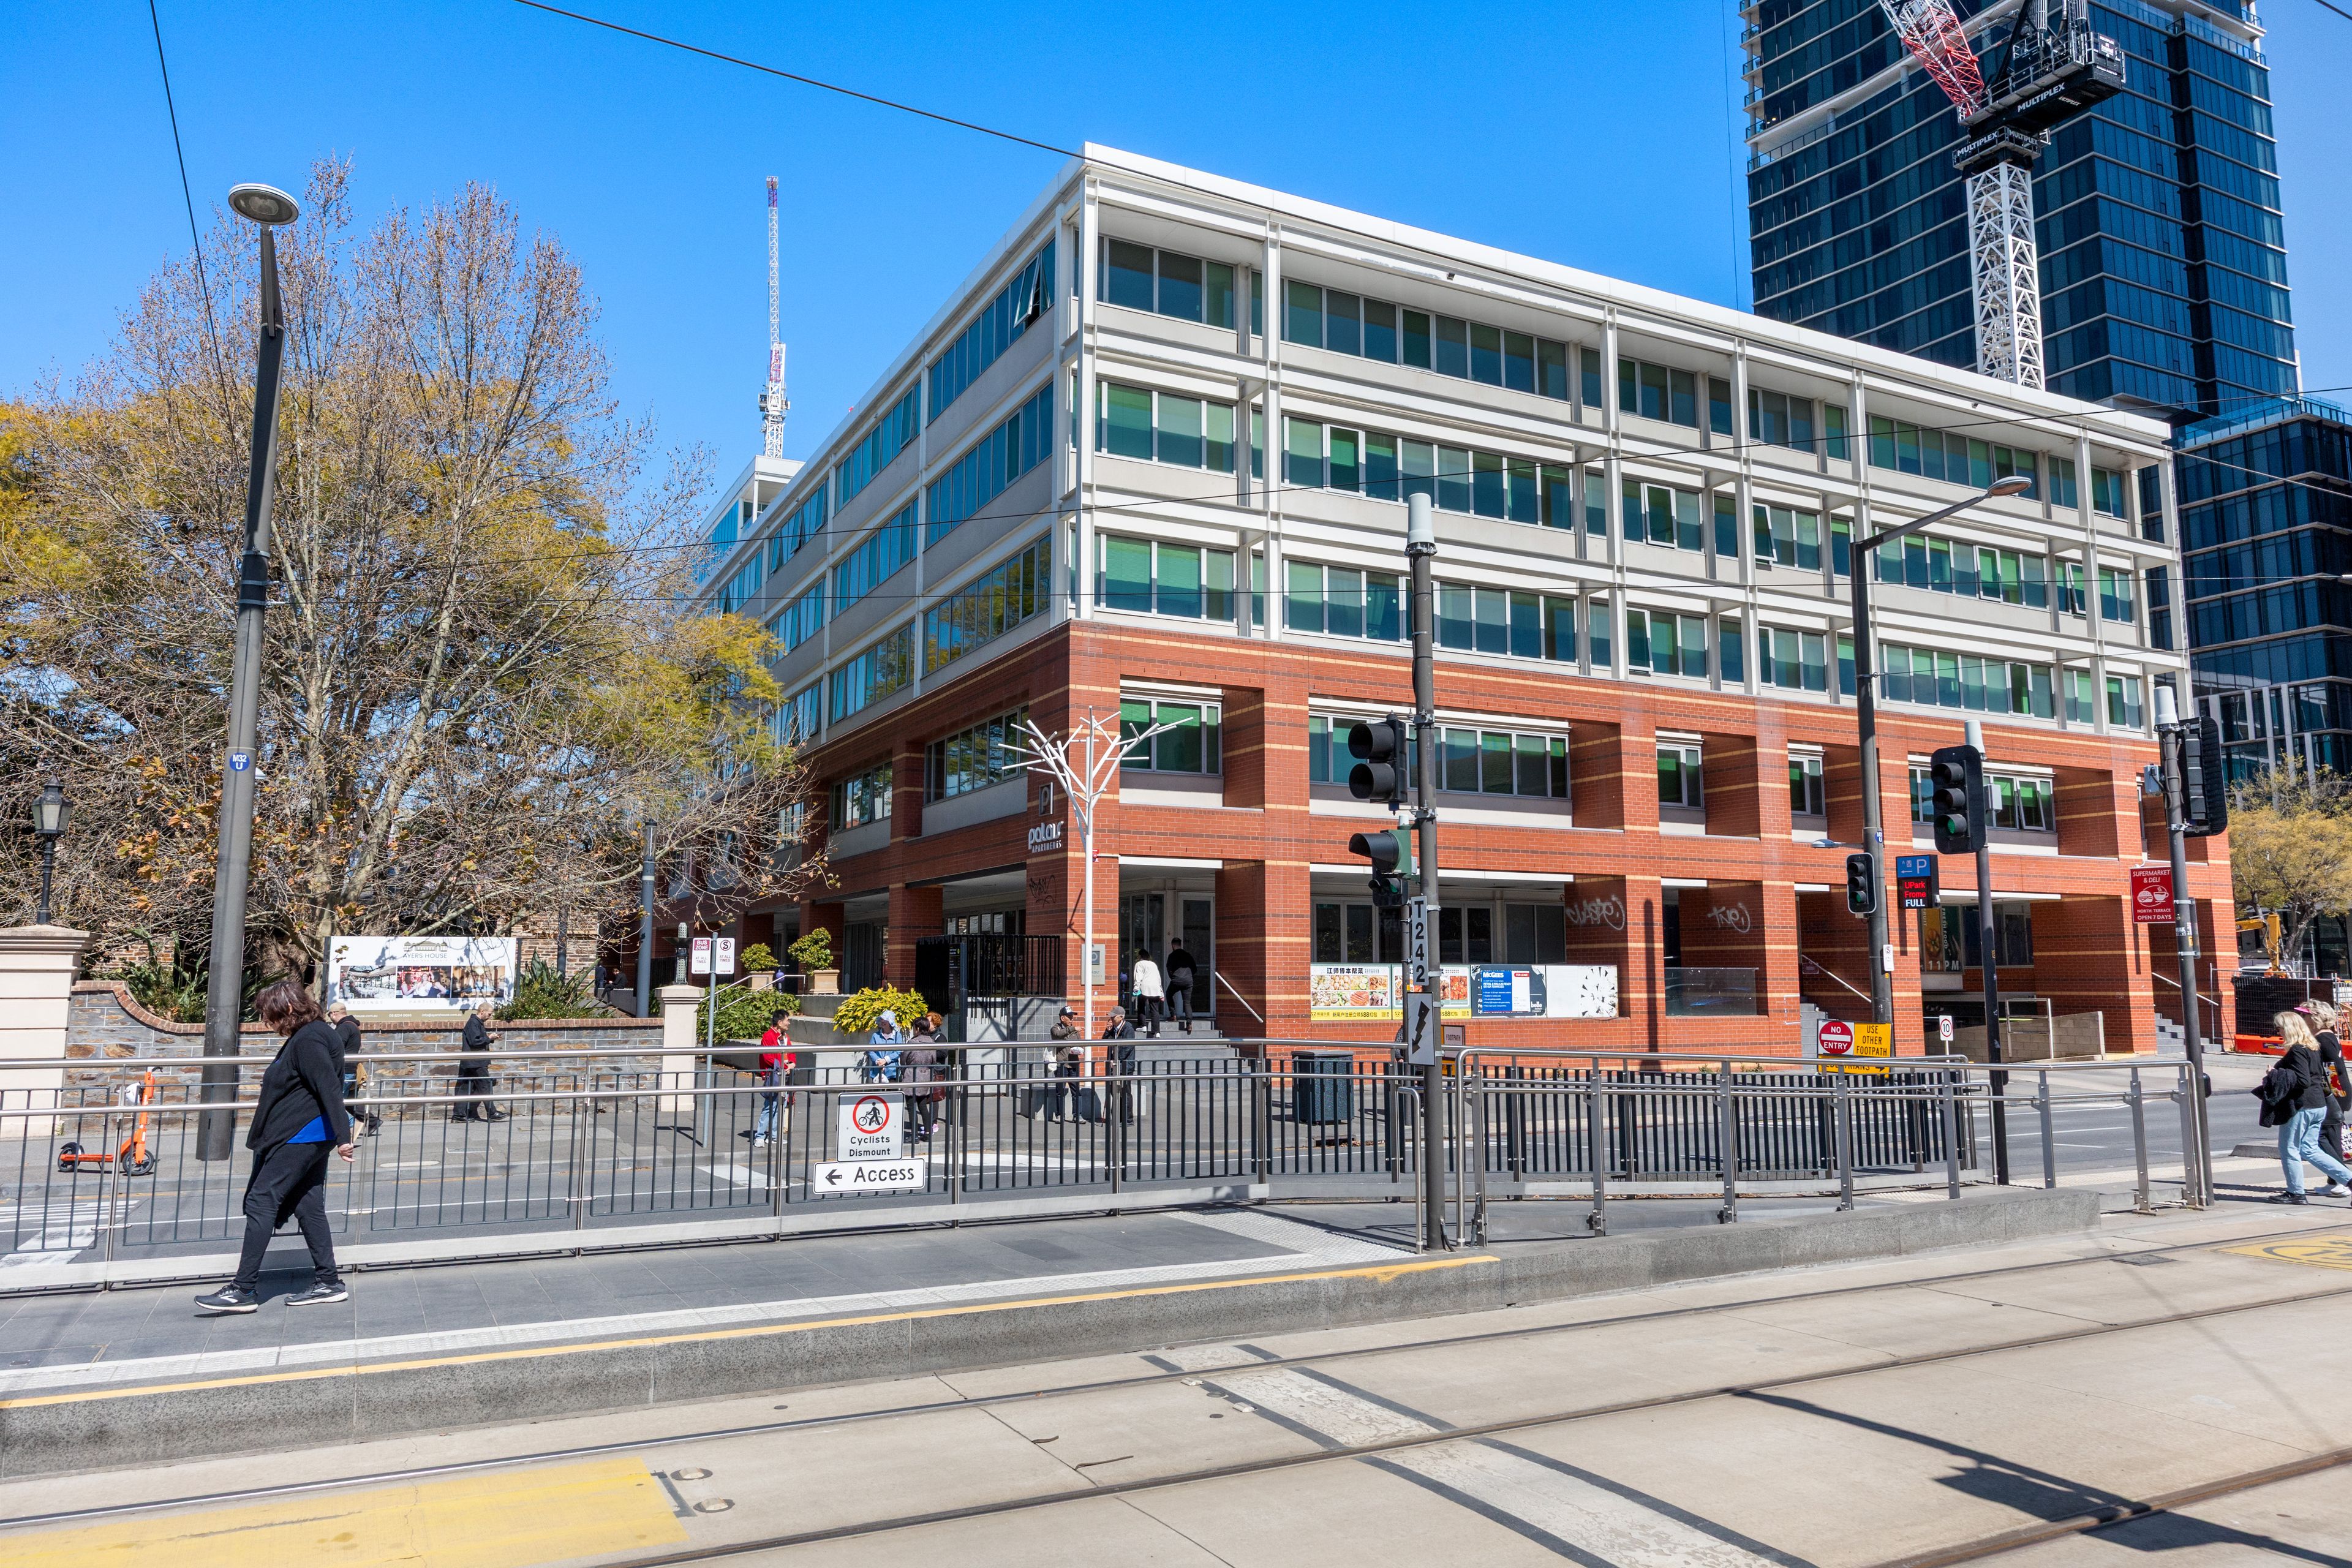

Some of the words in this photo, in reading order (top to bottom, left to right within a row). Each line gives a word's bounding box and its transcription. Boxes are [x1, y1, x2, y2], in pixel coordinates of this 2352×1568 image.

[2017, 82, 2066, 113] MULTIPLEX
[2008, 129, 2038, 146] MULTIPLEX
[1957, 130, 1997, 156] MULTIPLEX
[1031, 840, 1061, 853] APARTMENTS
[1917, 859, 1927, 874] P
[1905, 899, 1925, 907] FULL
[1866, 1025, 1879, 1034] USE
[1943, 1023, 1950, 1033] 10
[1862, 1035, 1882, 1045] OTHER
[1823, 1041, 1848, 1050] ENTRY
[1856, 1046, 1887, 1057] FOOTPATH
[850, 1136, 890, 1145] Cyclists
[849, 1148, 891, 1157] Dismount
[853, 1166, 914, 1183] Access
